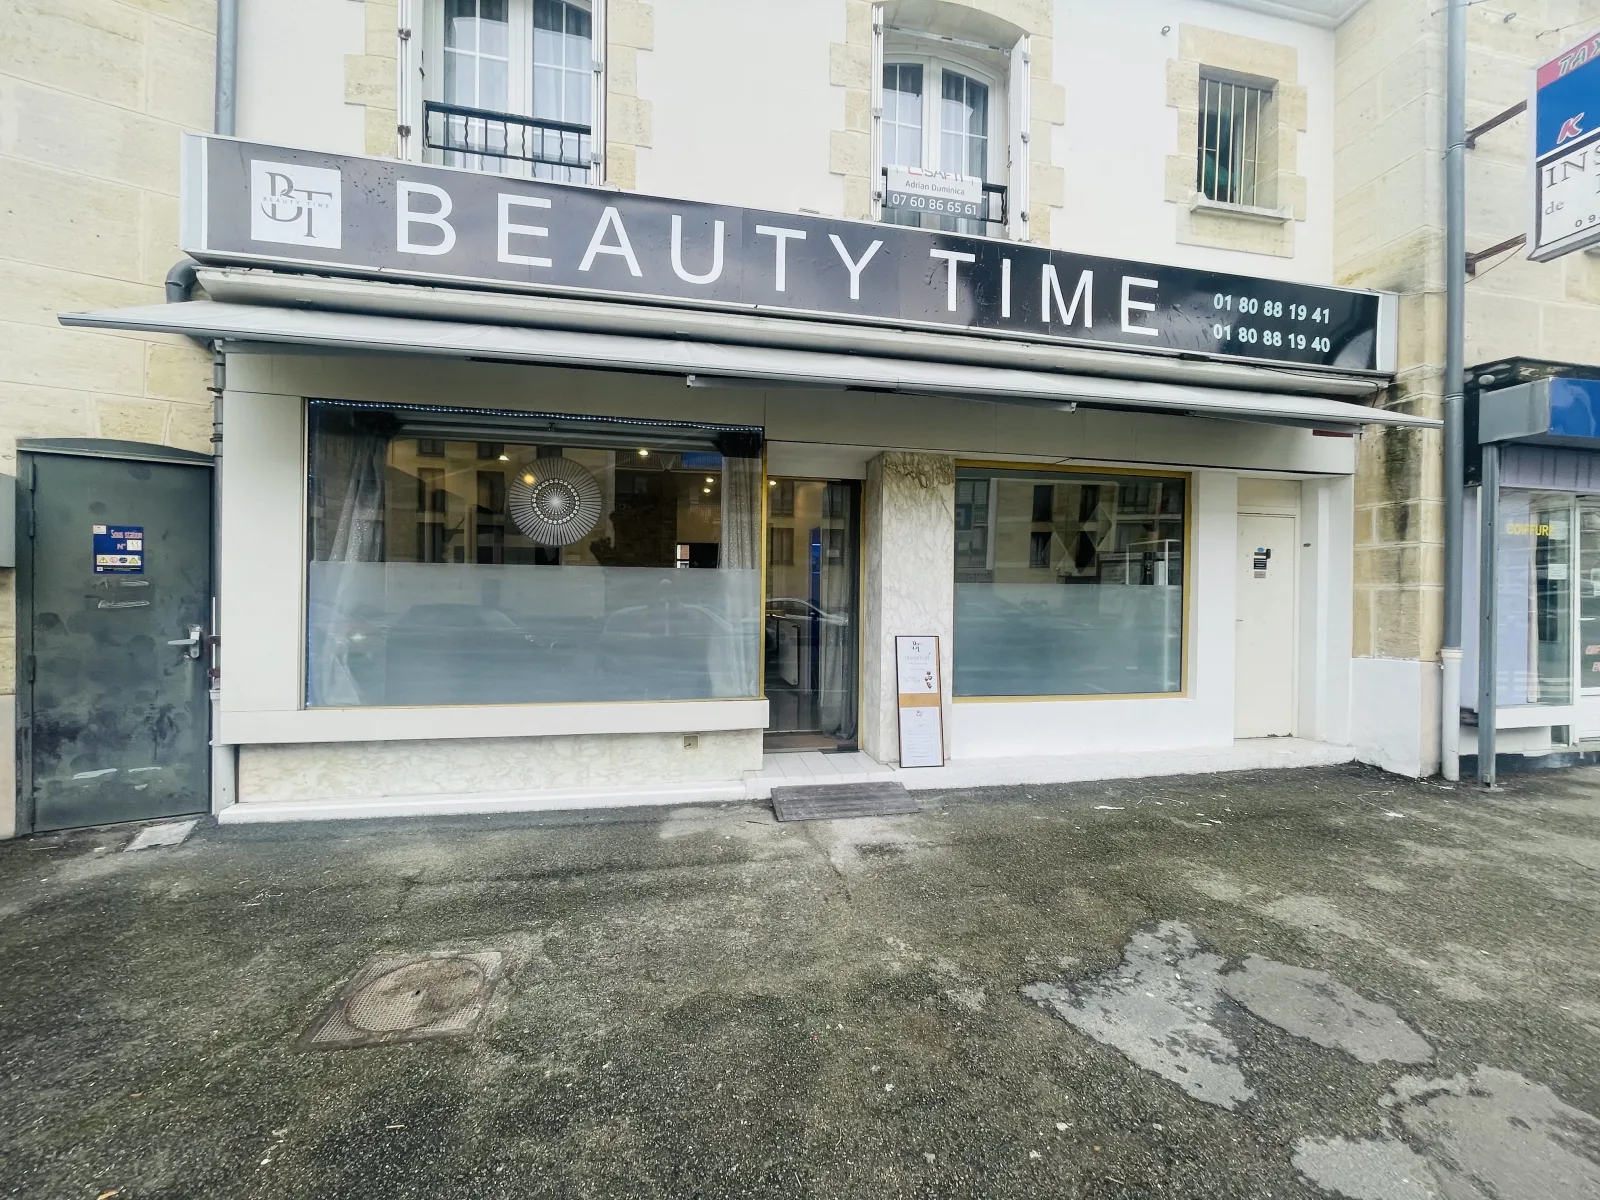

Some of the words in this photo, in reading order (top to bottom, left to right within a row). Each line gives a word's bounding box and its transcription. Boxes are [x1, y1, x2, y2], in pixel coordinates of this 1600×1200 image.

[1556, 111, 1585, 144] K
[905, 180, 930, 190] Adrian
[931, 184, 965, 196] Duminica
[263, 196, 301, 206] BEAUTY
[307, 201, 329, 209] TIME
[892, 193, 907, 206] 07
[910, 196, 925, 208] 60
[929, 199, 944, 211] 86
[947, 201, 961, 213] 65
[964, 204, 977, 215] 61
[1545, 201, 1565, 215] de
[396, 180, 884, 300] BEAUTY
[930, 249, 1159, 337] TIME
[1213, 293, 1232, 311] 01
[1238, 296, 1258, 315] 80
[1263, 300, 1283, 318] 88
[1289, 303, 1307, 321] 19
[1311, 307, 1329, 324] 41
[1213, 323, 1231, 341] 01
[1238, 326, 1258, 344] 80
[1263, 329, 1282, 347] 88
[1288, 333, 1307, 350] 19
[1310, 336, 1331, 353] 40
[1506, 523, 1553, 536] COIFFURE
